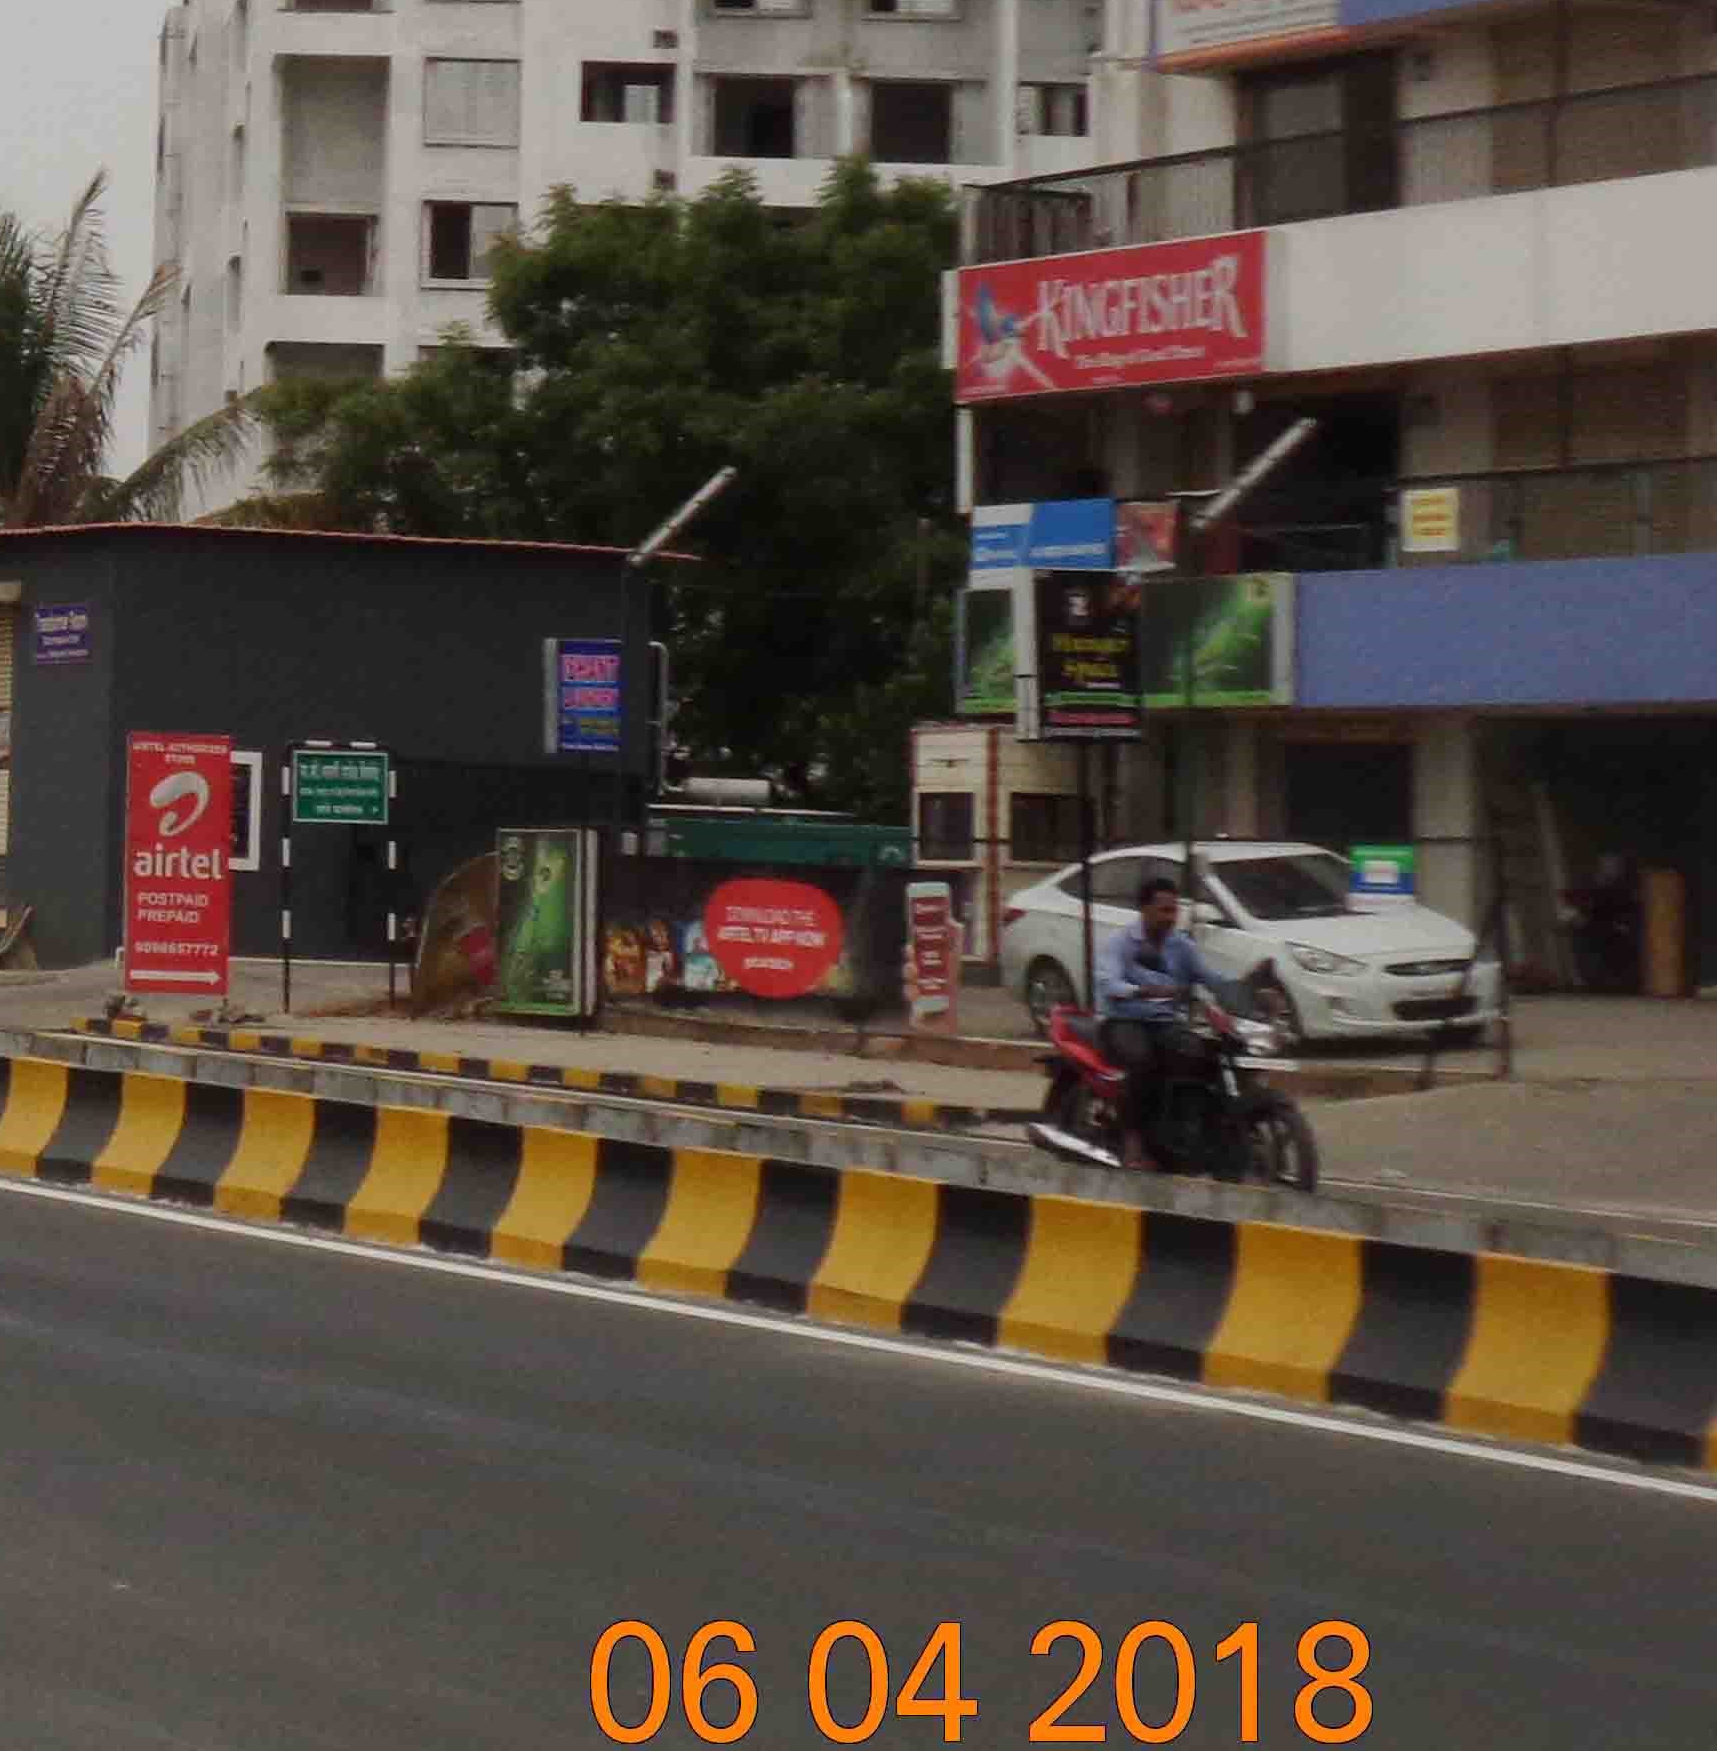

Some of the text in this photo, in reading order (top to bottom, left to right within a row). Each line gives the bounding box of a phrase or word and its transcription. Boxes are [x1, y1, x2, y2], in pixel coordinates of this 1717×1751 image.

[1036, 253, 1249, 360] KINGFISHER
[133, 843, 223, 880] airtel
[138, 891, 209, 908] POSTPAID
[137, 909, 200, 924] PREPAID
